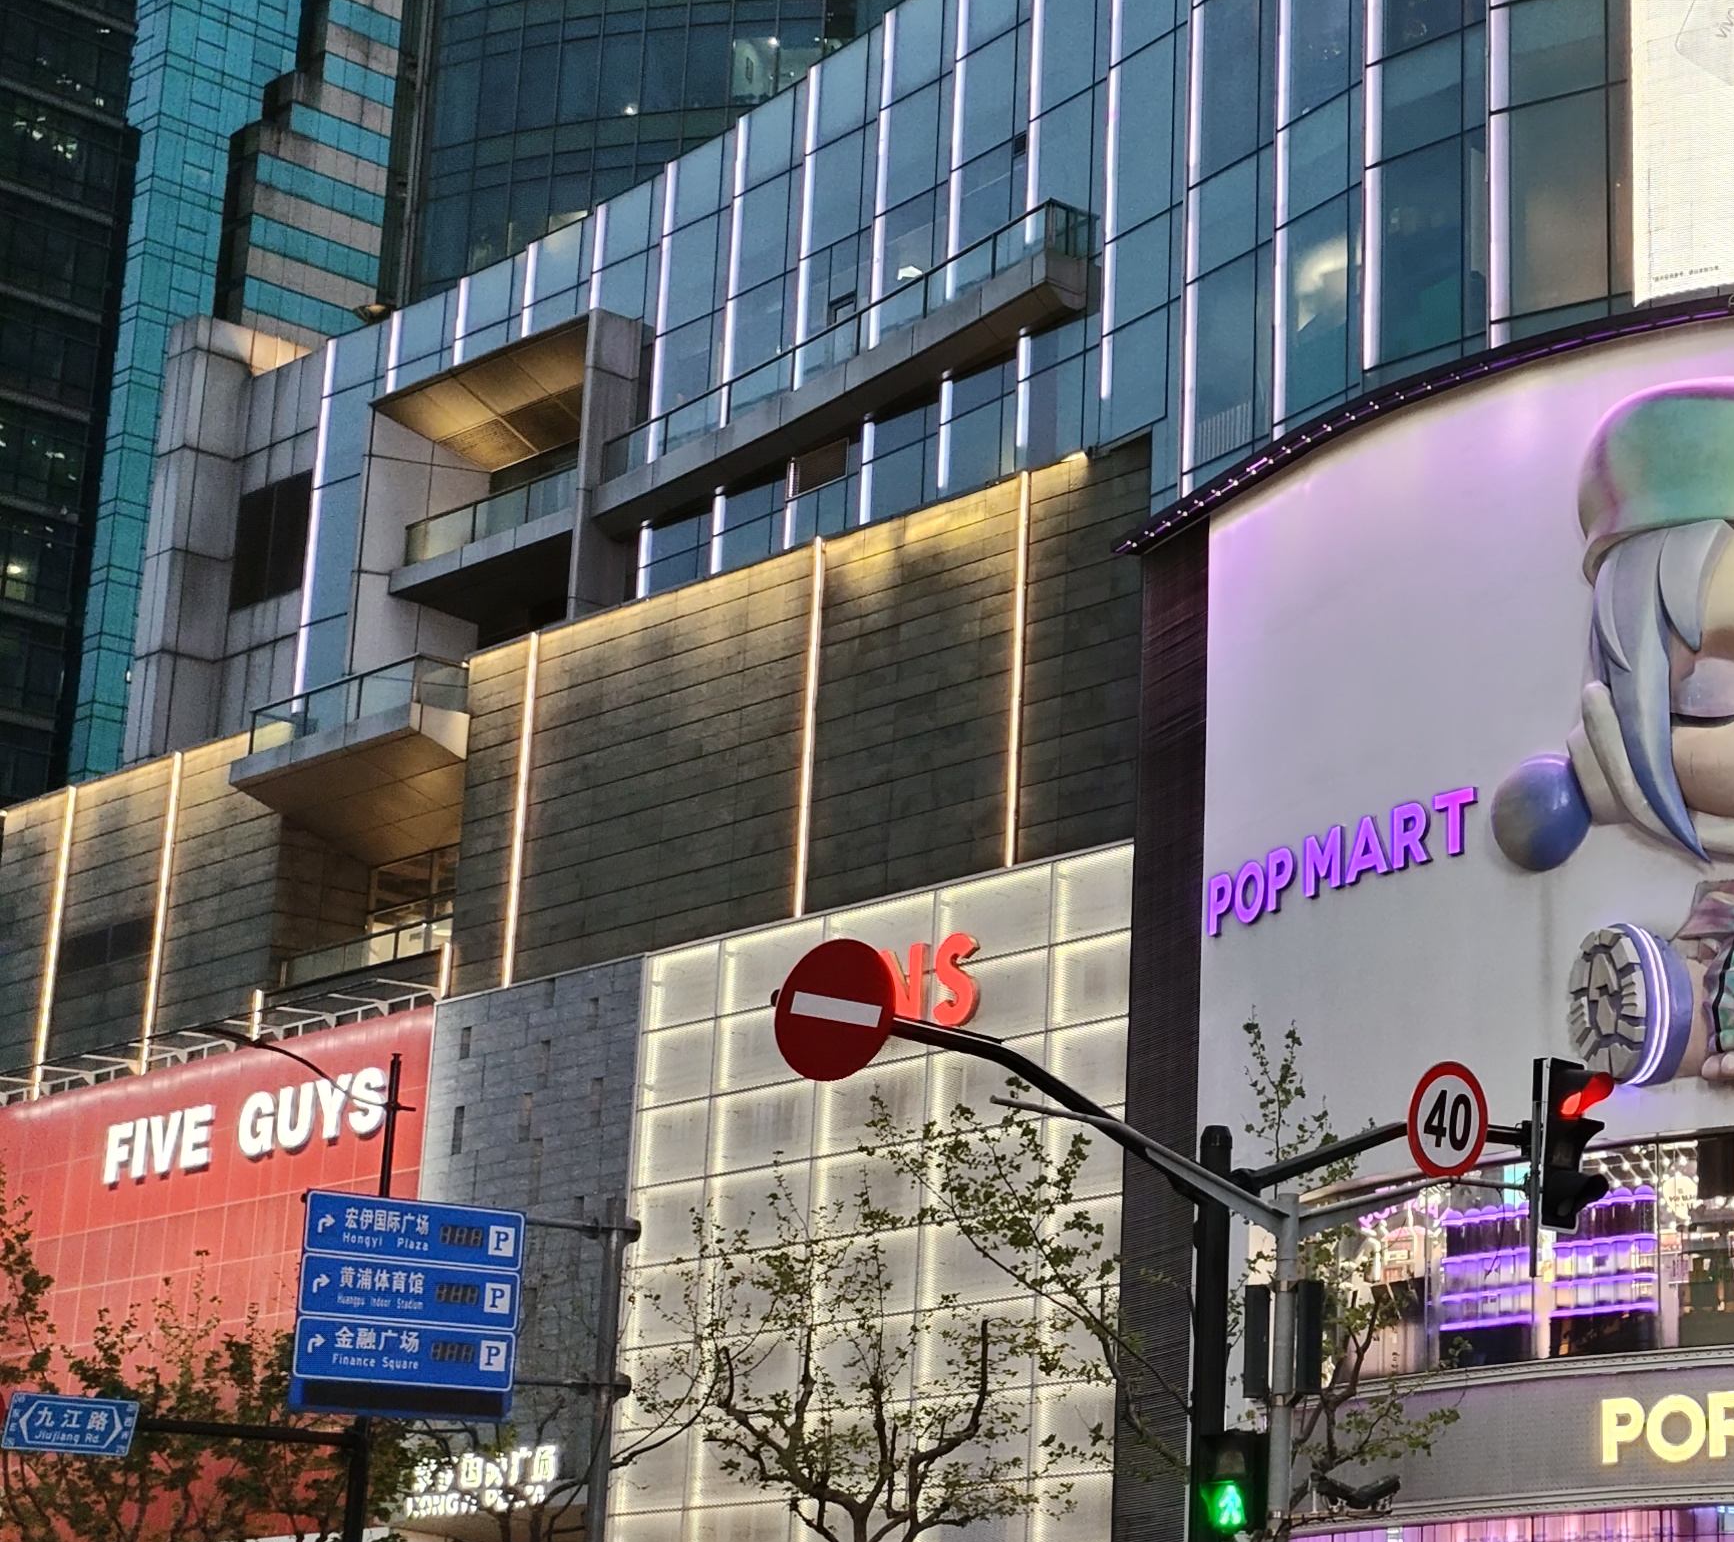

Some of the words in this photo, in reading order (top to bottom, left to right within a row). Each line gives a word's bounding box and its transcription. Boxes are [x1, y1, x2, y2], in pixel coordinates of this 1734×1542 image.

[1206, 846, 1297, 938] POP
[1302, 786, 1479, 899] MART
[102, 1101, 217, 1187] FIVE
[236, 1065, 391, 1161] GUYS
[1423, 1088, 1473, 1152] 40
[344, 1207, 430, 1236] 宏伊国际广场
[342, 1232, 384, 1248] Hongyi
[396, 1237, 430, 1252] Plaza
[494, 1230, 510, 1252] P
[339, 1266, 425, 1295] 黄浦体育馆
[396, 1295, 424, 1310] Stadium
[490, 1287, 505, 1309] P
[334, 1325, 420, 1354] 金融广场
[332, 1353, 376, 1368] Finance
[381, 1356, 419, 1371] Square
[485, 1345, 501, 1366] P
[34, 1406, 109, 1432] 九江路
[34, 1430, 81, 1445] Jiujiang
[85, 1434, 100, 1444] Rd
